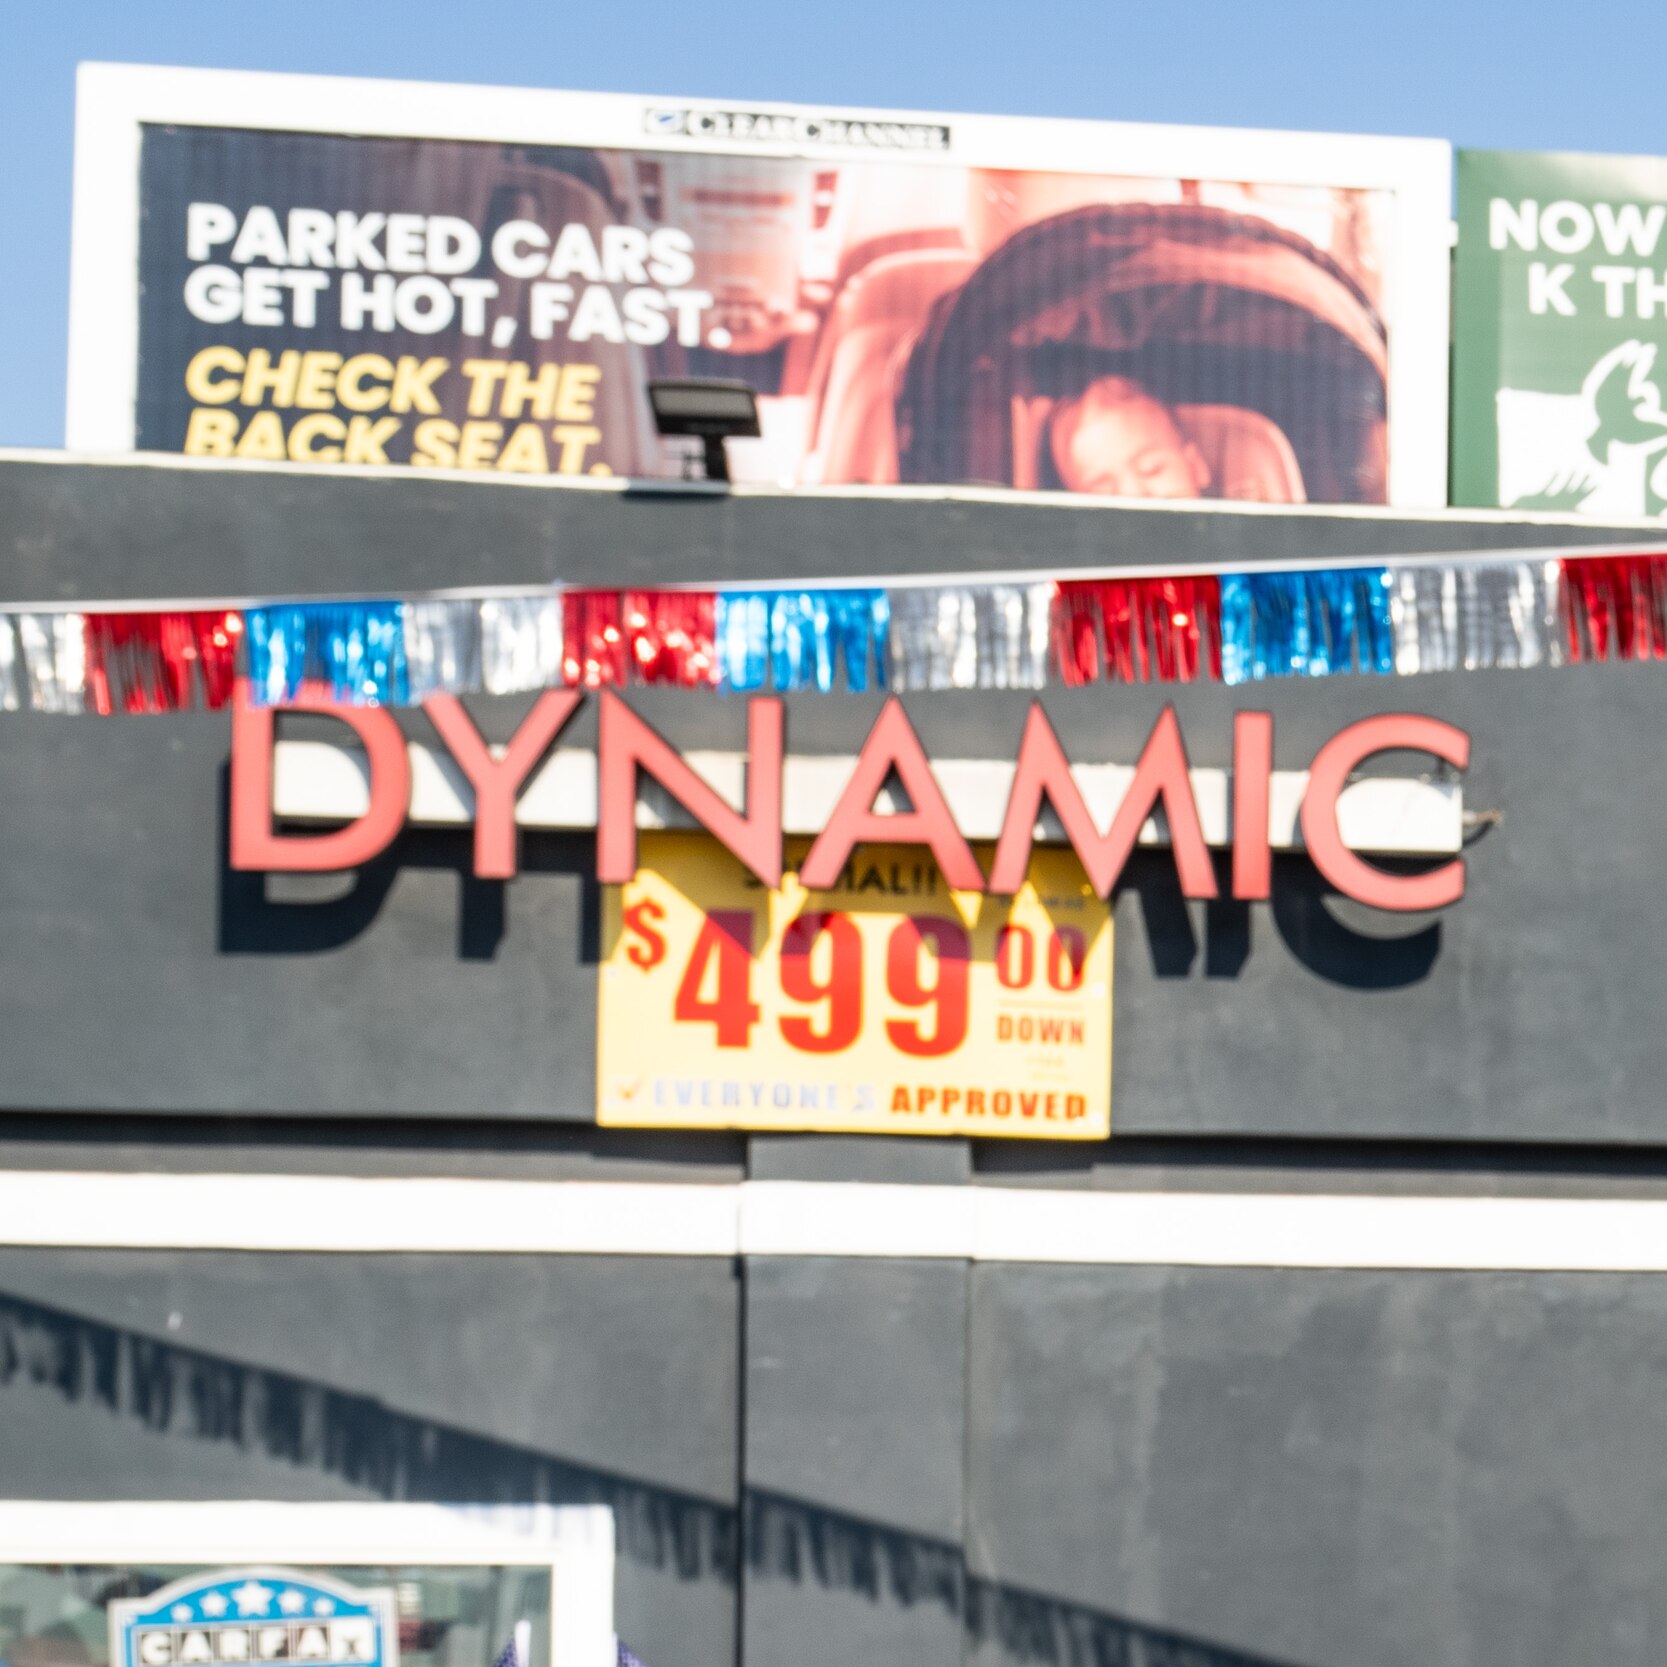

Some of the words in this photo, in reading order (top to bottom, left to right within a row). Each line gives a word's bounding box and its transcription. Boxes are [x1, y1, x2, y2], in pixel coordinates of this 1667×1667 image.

[186, 202, 482, 275] PARKED
[491, 219, 695, 287] CARS
[1489, 197, 1667, 257] NOW
[184, 264, 331, 328] GET
[340, 271, 518, 349] HOT,
[530, 281, 733, 350] FAST.
[1528, 261, 1578, 317] K
[185, 345, 450, 415] CHECK
[461, 358, 602, 422] THE
[184, 407, 402, 464] BACK
[229, 676, 1473, 913] DYNAMIC
[996, 1015, 1085, 1046] DOWN
[890, 1085, 1087, 1121] APPROVED
[139, 1617, 374, 1666] CARFAX
